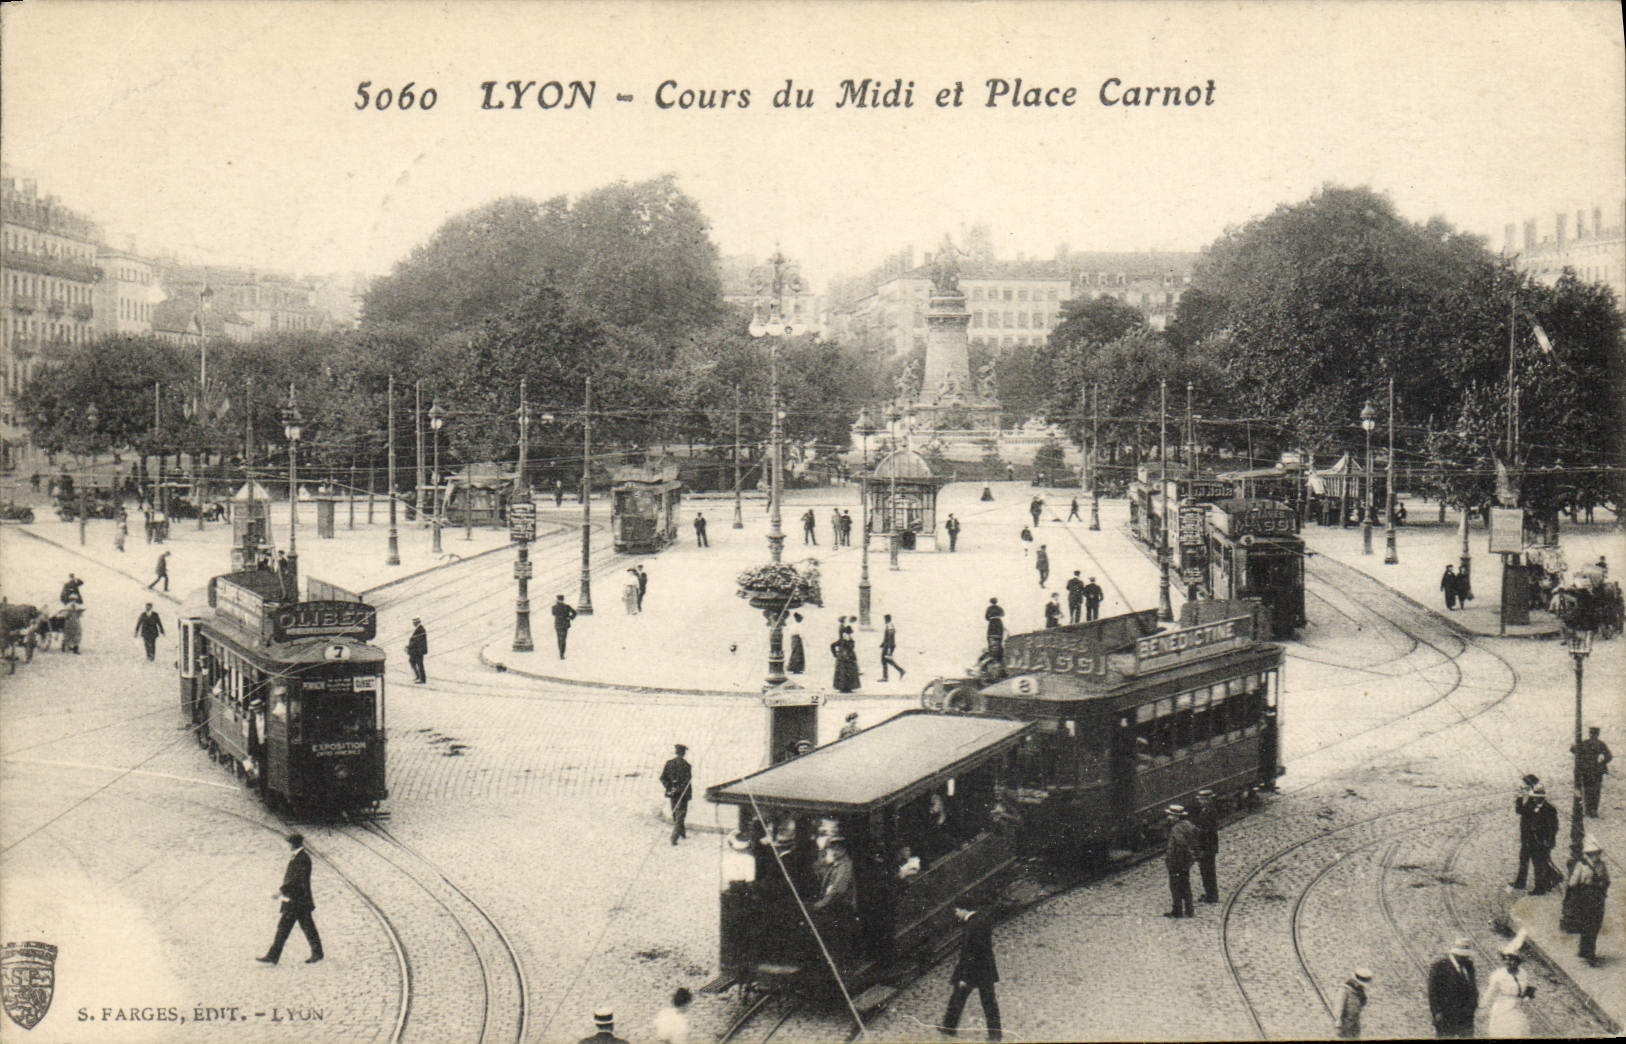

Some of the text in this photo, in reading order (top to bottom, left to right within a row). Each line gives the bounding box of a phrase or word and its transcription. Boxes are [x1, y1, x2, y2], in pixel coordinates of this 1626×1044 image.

[280, 610, 370, 629] OLIBET
[333, 646, 344, 658] 7
[1005, 648, 1106, 676] MASSI
